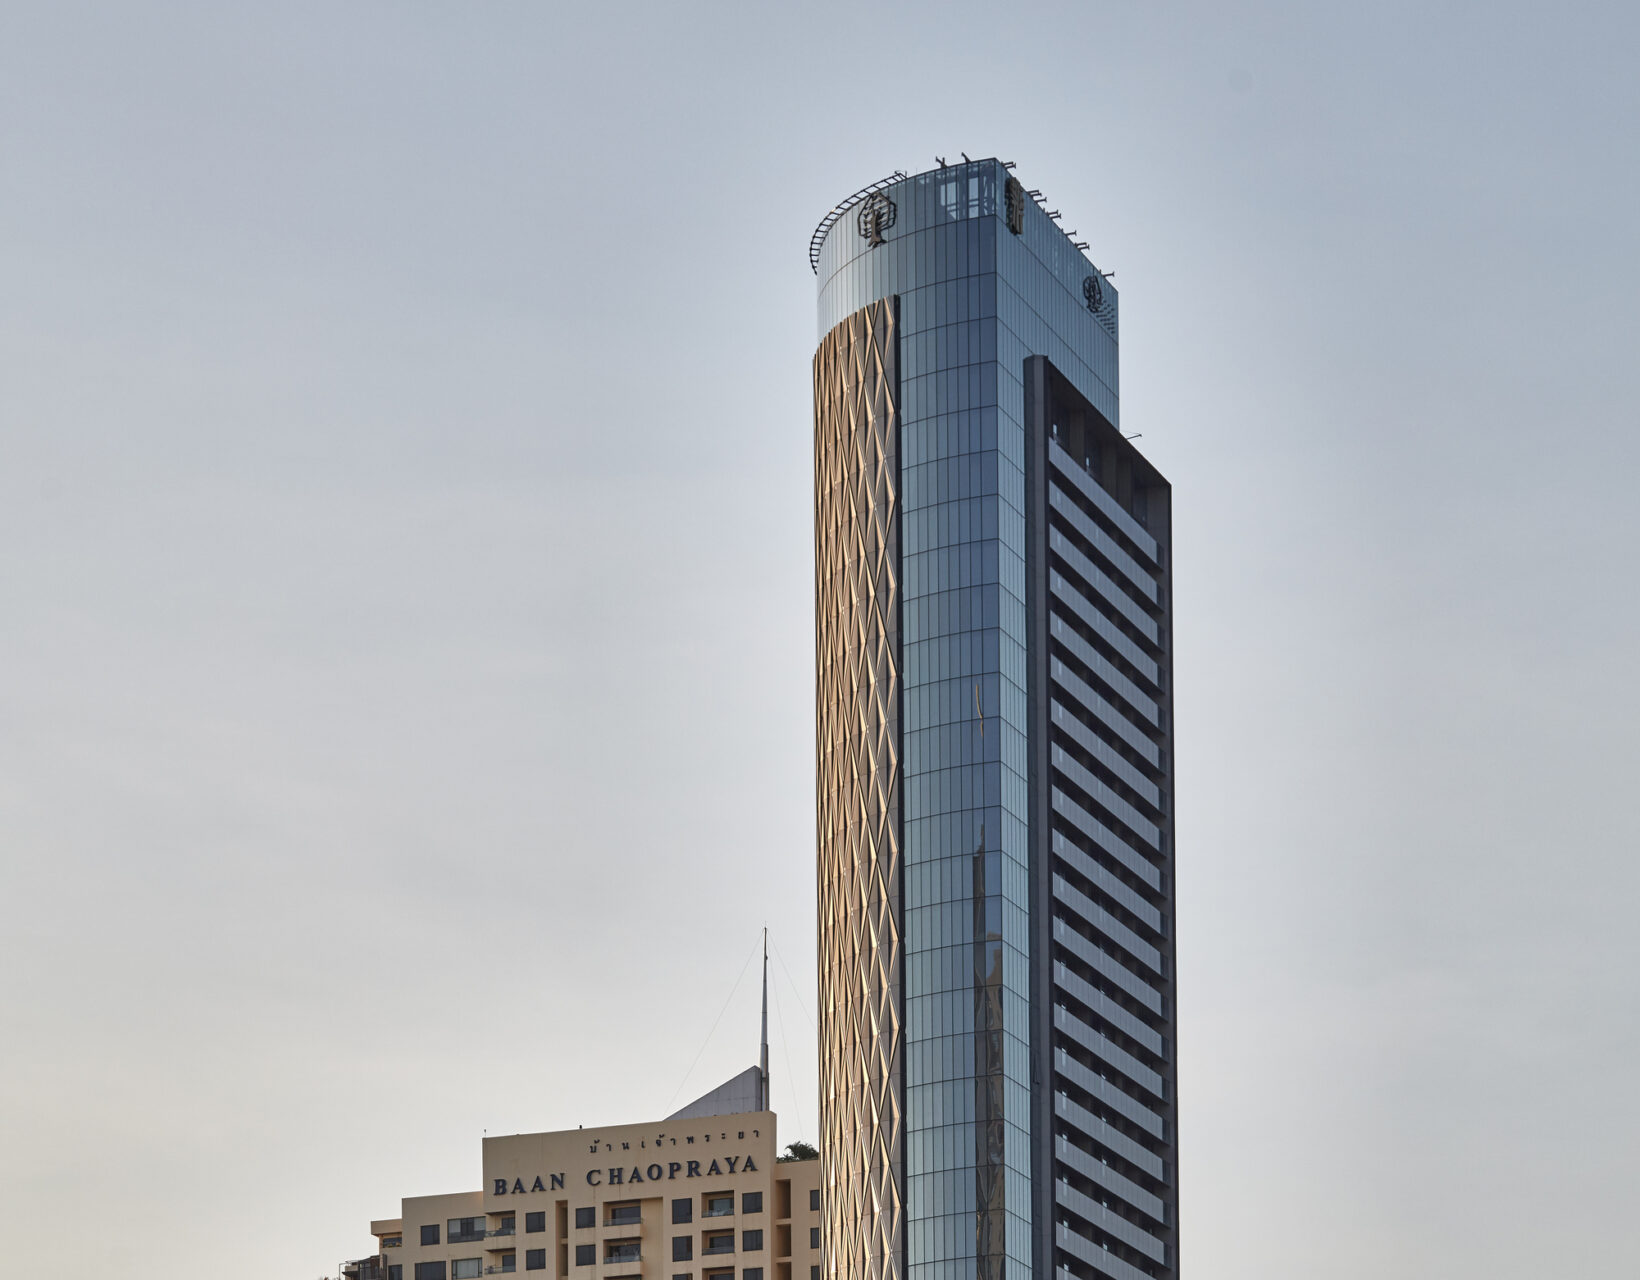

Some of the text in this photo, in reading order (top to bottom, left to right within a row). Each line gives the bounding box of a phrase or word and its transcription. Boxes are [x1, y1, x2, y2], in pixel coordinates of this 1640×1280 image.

[589, 1129, 760, 1154] บ้านเจ้าพระยา
[493, 1155, 758, 1196] BAAN CHAOPRAYA
